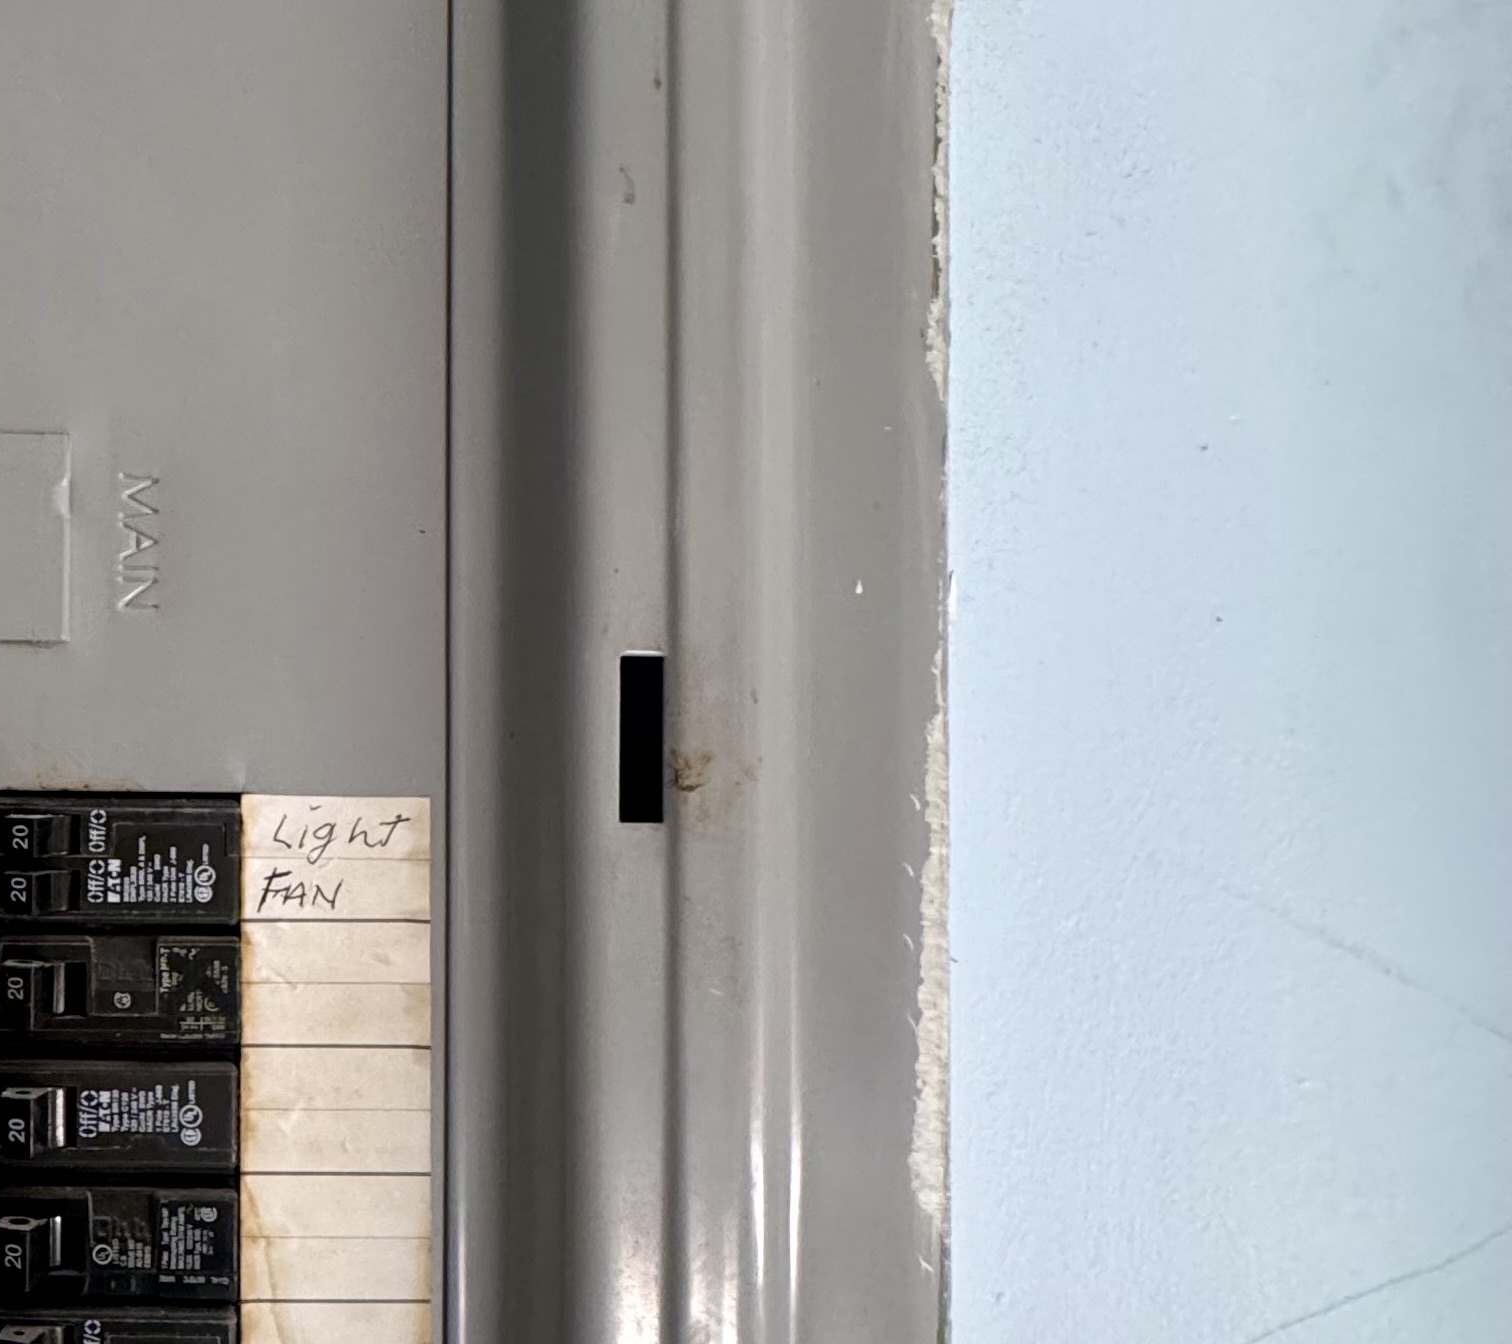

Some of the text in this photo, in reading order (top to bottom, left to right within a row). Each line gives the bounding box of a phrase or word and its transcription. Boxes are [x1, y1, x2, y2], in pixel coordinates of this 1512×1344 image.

[117, 471, 160, 611] MAIN
[12, 823, 29, 849] 20
[10, 876, 27, 903] 20
[257, 867, 343, 913] FAN
[7, 976, 24, 1001] 20
[9, 1118, 26, 1144] 20
[4, 1244, 23, 1270] 20
